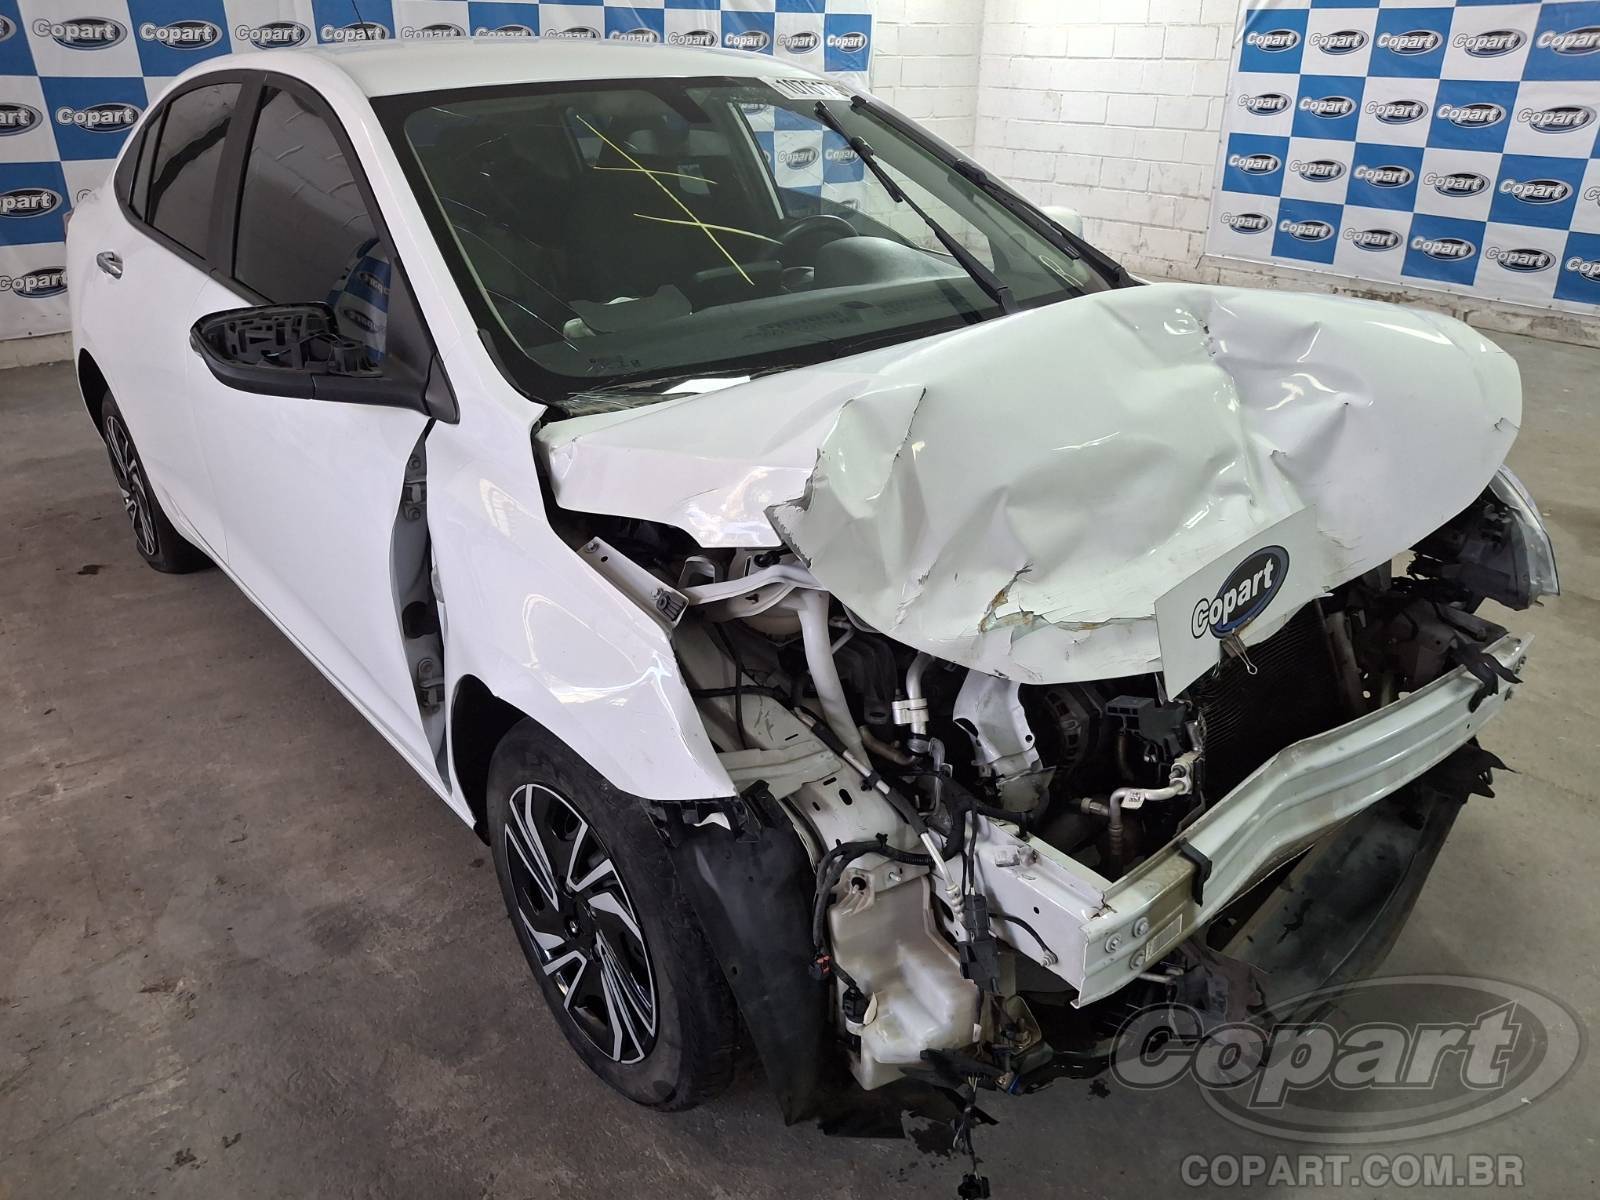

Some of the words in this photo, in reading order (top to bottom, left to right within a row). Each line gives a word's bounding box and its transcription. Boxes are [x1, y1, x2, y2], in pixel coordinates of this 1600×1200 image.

[32, 18, 115, 43] Copart
[139, 21, 213, 42] Copart
[235, 24, 300, 43] Copart
[320, 24, 382, 41] Copart
[668, 32, 712, 46] Copart
[723, 33, 764, 48] Copart
[777, 33, 814, 48] Copart
[826, 33, 863, 48] Copart
[1247, 31, 1294, 49] Copart
[1309, 32, 1360, 49] Copart
[1377, 33, 1434, 49] Copart
[1453, 33, 1515, 52] Copart
[1537, 30, 1600, 50] Copar
[1238, 94, 1286, 111] Copart
[1300, 97, 1349, 114] Copart
[1365, 101, 1419, 116] Copart
[0, 108, 29, 126] art
[56, 106, 134, 128] Copart
[1436, 103, 1498, 123] Copart
[1517, 107, 1585, 127] Copart
[779, 150, 815, 166] Copart
[1229, 154, 1275, 170] Copart
[1289, 159, 1338, 177] Copart
[1354, 164, 1408, 182] Copart
[1423, 172, 1481, 191] Copart
[1500, 178, 1564, 199] Copart
[0, 191, 51, 214] part
[1221, 212, 1266, 229] Copart
[1280, 219, 1328, 237] Copart
[1343, 228, 1395, 246] Copart
[1411, 236, 1468, 256] Copart
[1486, 246, 1547, 267] Copart
[1566, 257, 1600, 277] Cop
[1191, 557, 1274, 639] Copart
